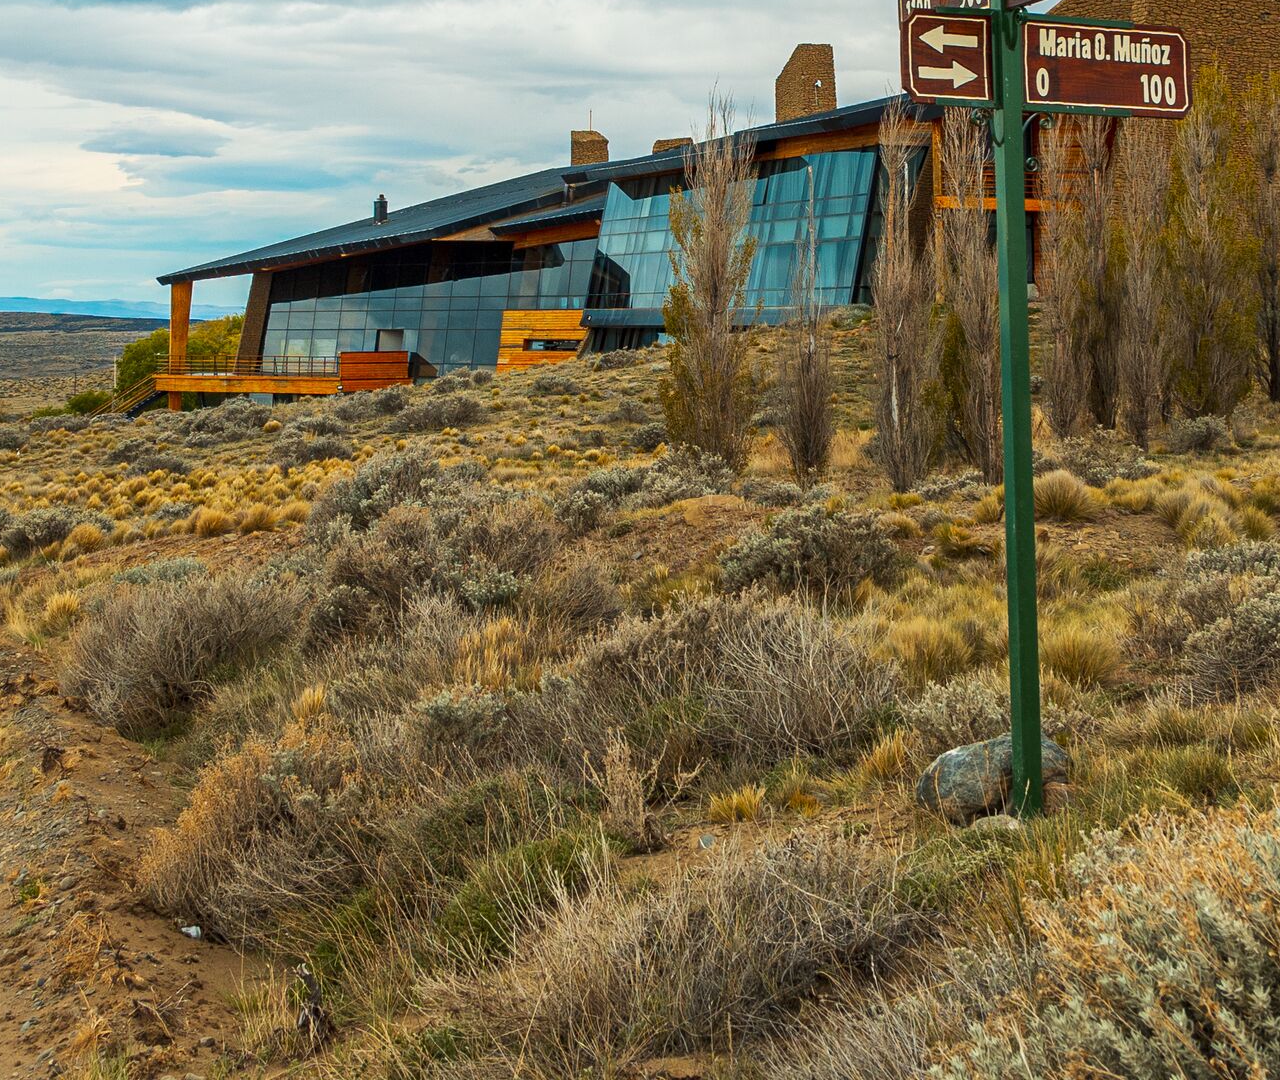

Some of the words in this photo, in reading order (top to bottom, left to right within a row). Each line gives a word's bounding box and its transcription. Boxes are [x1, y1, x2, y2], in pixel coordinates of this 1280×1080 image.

[1113, 34, 1171, 65] Muñoz
[1035, 67, 1050, 97] 0
[1140, 74, 1177, 106] 100
